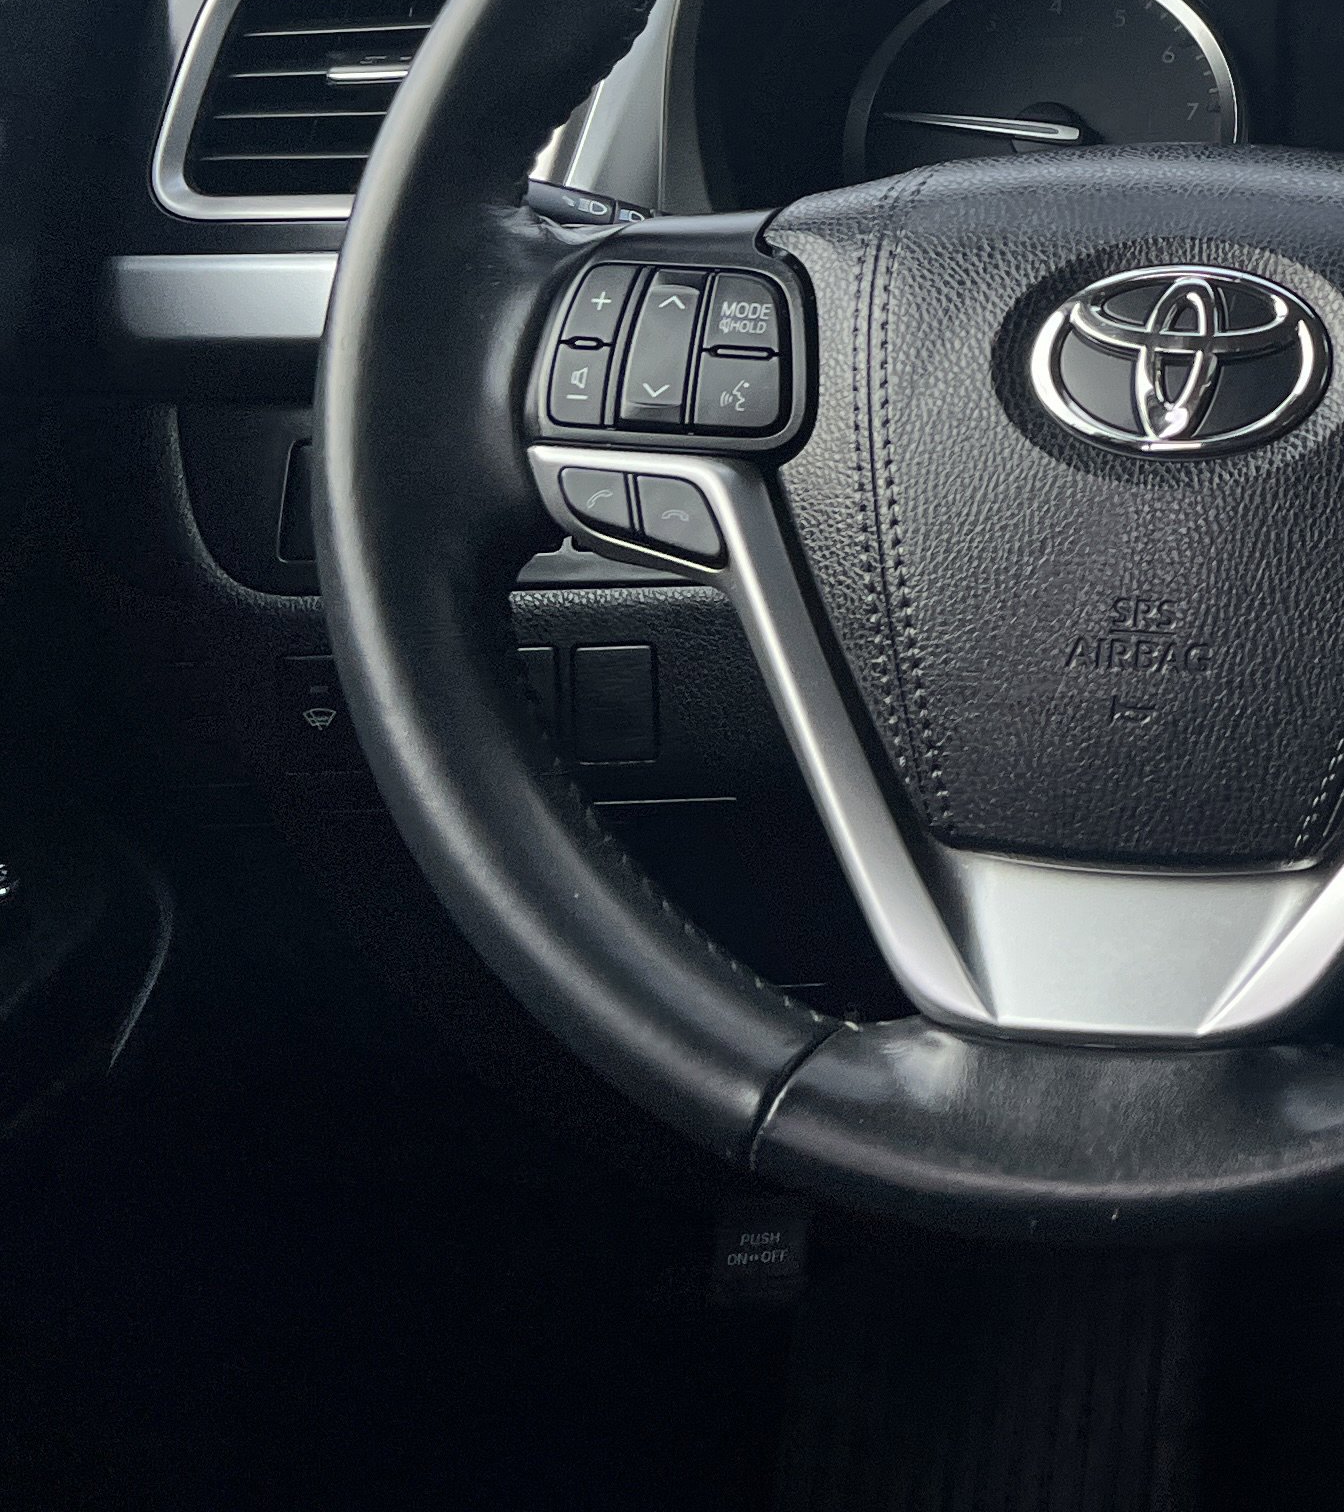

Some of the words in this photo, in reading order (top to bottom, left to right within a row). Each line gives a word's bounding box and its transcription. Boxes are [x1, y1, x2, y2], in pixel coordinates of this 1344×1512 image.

[1161, 46, 1176, 64] 6
[1186, 102, 1200, 121] 7
[720, 301, 772, 319] MODE
[730, 319, 767, 334] HOLD
[1063, 638, 1214, 673] AIRBAG
[740, 1232, 781, 1246] PUSH
